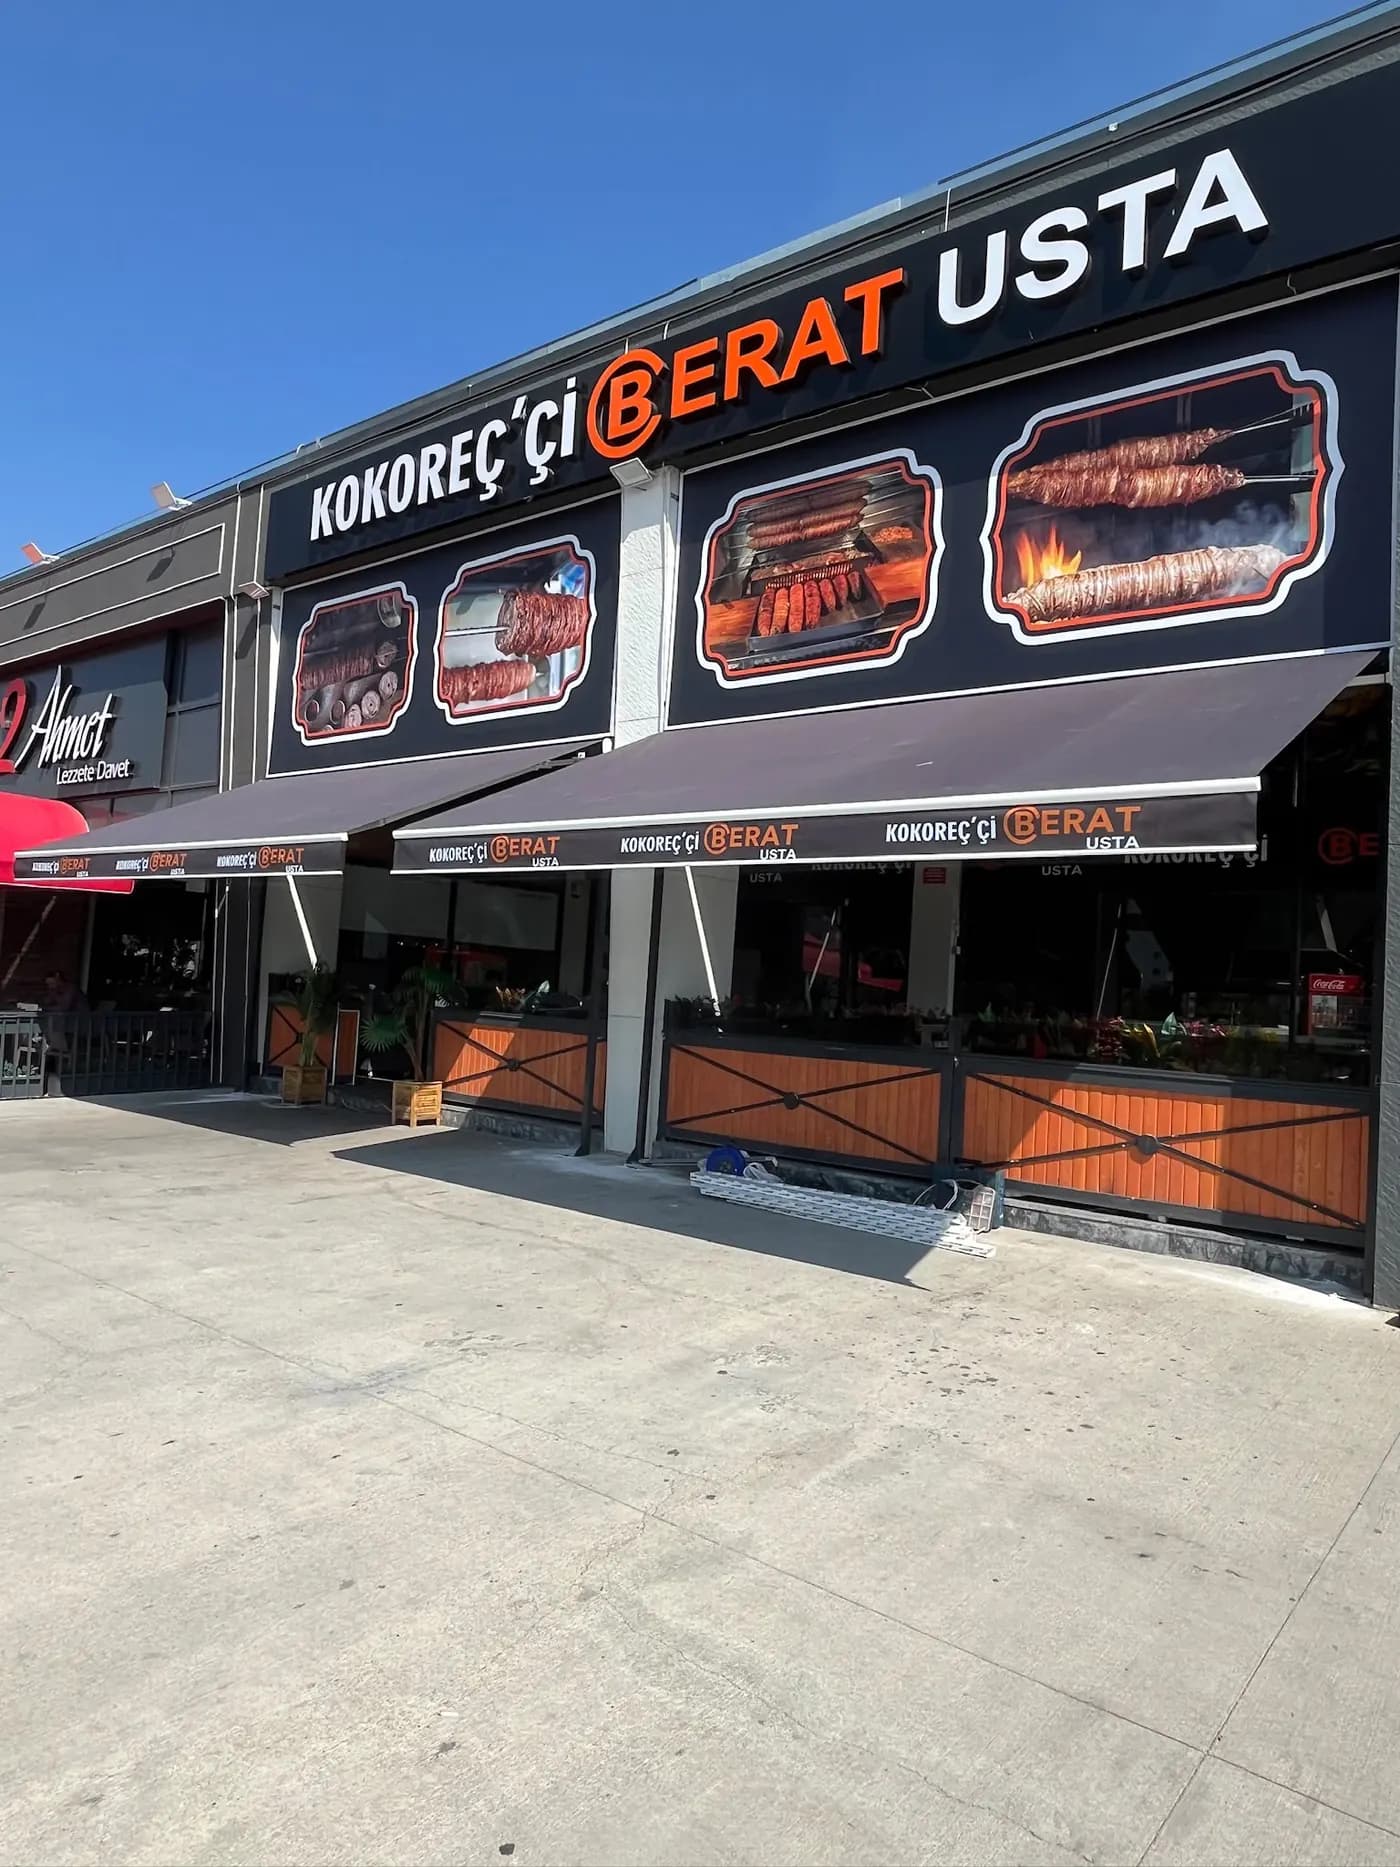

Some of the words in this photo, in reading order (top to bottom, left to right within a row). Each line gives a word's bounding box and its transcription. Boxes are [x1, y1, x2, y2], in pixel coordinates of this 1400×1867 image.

[587, 267, 905, 458] BERAT
[937, 148, 1270, 326] USTA
[14, 664, 113, 769] Ahmet
[56, 764, 95, 785] Lezzete
[97, 759, 131, 780] Davet
[1003, 806, 1142, 845] BERAT
[704, 822, 799, 854] BERAT
[1086, 836, 1141, 849] USTA
[258, 846, 305, 869] BERAT
[491, 835, 560, 863] BERAT
[759, 848, 798, 860] USTA
[150, 852, 188, 872] BERAT
[285, 864, 304, 873] USTA
[532, 856, 560, 867] USTA
[1041, 864, 1083, 876] USTA
[749, 872, 783, 883] USTA
